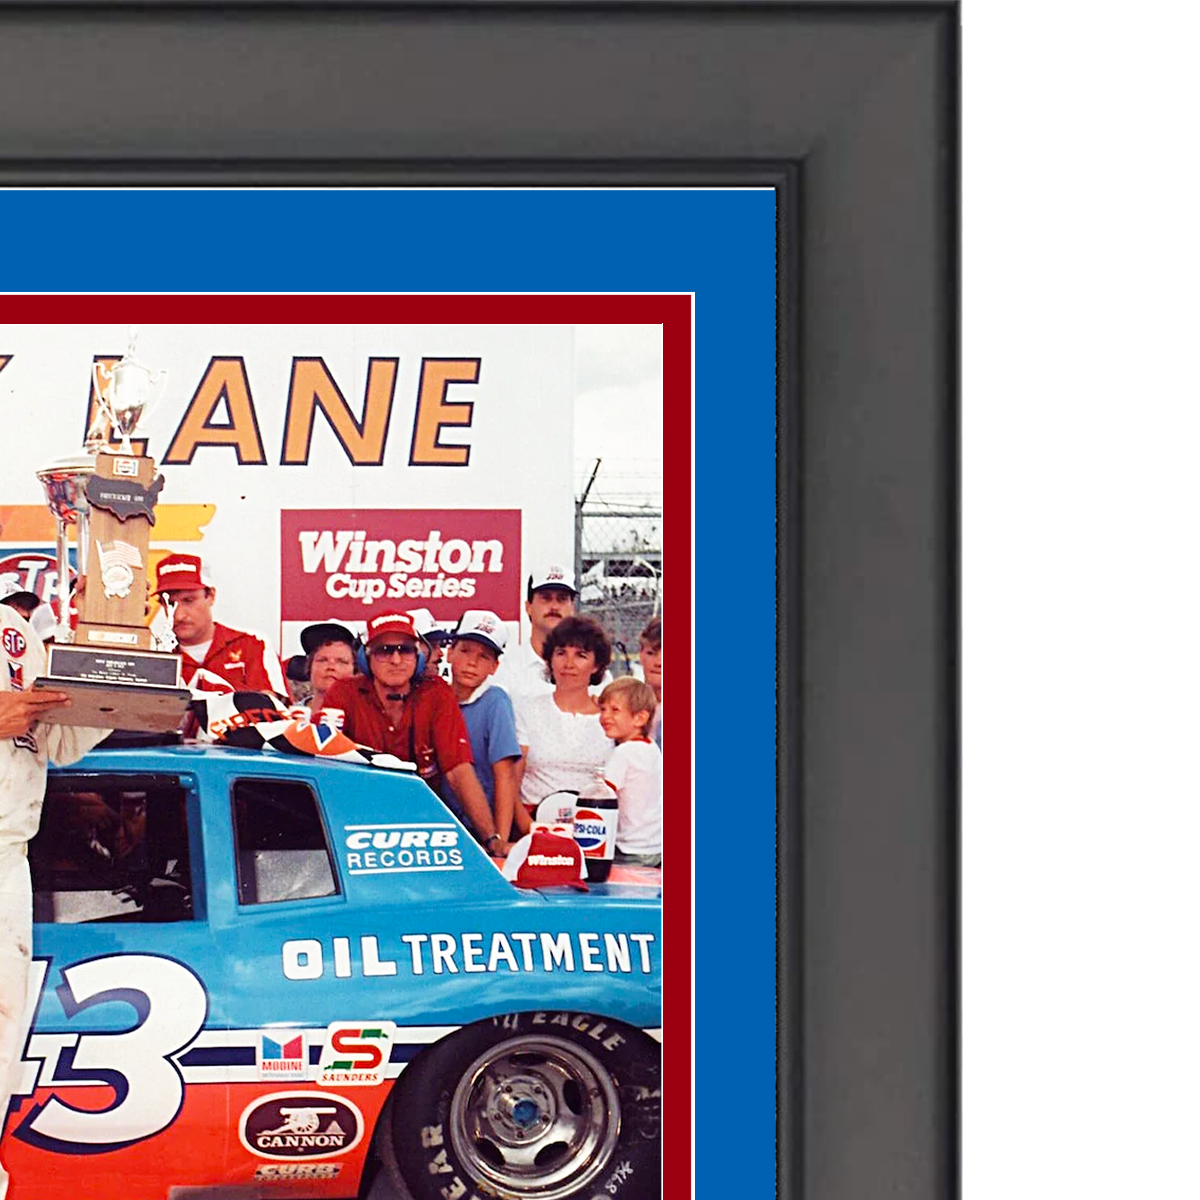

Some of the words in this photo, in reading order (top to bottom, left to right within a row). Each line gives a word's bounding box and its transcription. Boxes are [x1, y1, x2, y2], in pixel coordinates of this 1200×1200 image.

[83, 355, 482, 467] LANE
[298, 530, 504, 574] Winston
[325, 573, 386, 604] Cup
[387, 573, 476, 598] Series
[3, 630, 26, 653] STP
[574, 823, 606, 836] PSI-COLA
[345, 830, 458, 849] CURB
[346, 849, 463, 868] RECORDS
[527, 853, 575, 867] Winston
[281, 935, 397, 981] OIL
[401, 931, 655, 975] TREATMENT
[321, 1073, 379, 1082] SAUNDERS
[256, 1135, 345, 1148] CANNON
